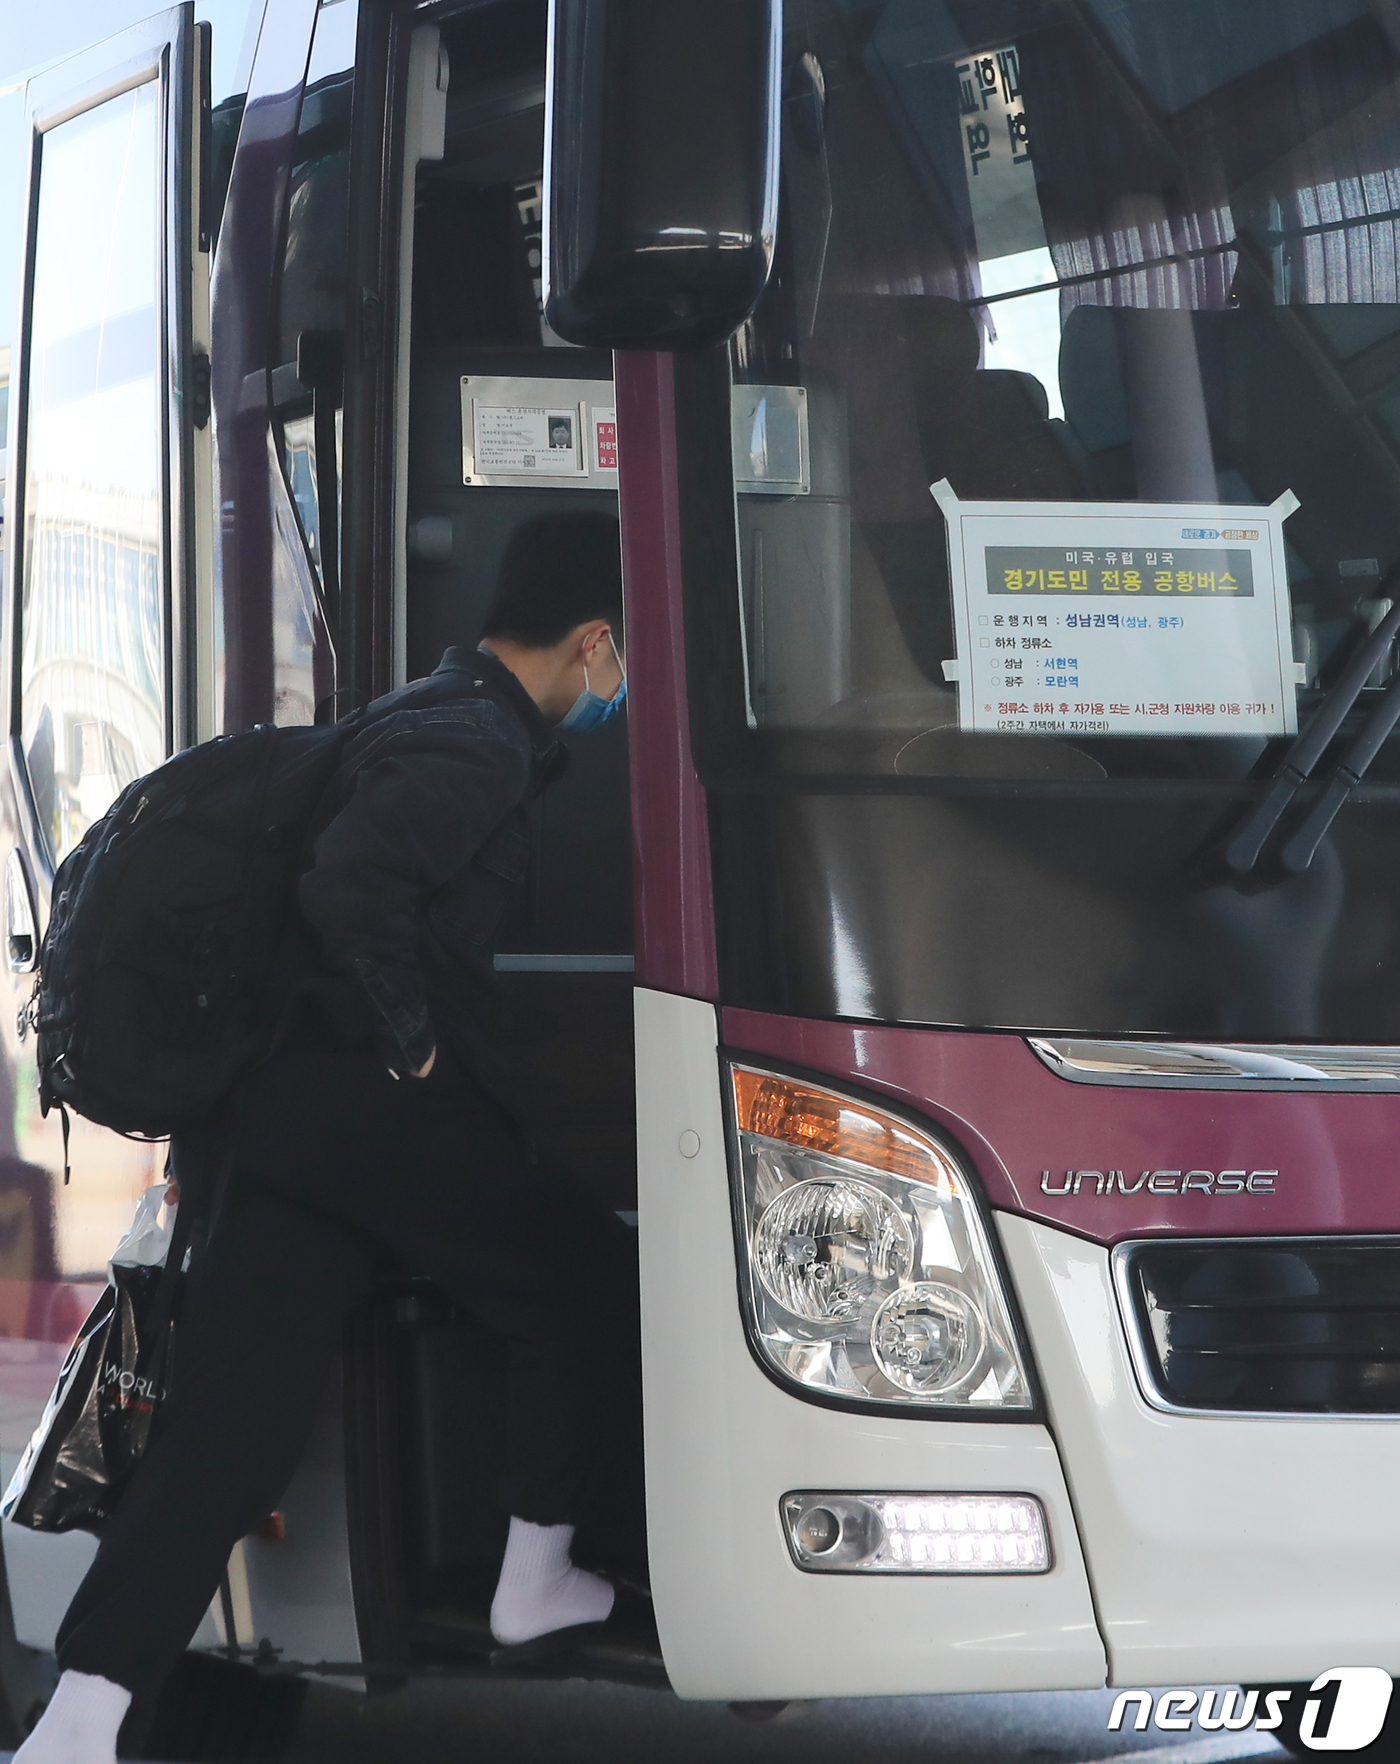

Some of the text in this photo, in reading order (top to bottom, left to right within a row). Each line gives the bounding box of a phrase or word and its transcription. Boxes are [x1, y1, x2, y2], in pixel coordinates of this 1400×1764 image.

[1145, 552, 1174, 566] 입국
[1004, 569, 1238, 593] 경기도민 전용 공항버스
[1157, 616, 1184, 628] 광주)
[995, 637, 1053, 649] 하차 정류소
[1004, 658, 1023, 670] 성남
[1044, 658, 1078, 670] 서현역
[1005, 676, 1024, 687] 광주
[1045, 676, 1079, 687] 모란역
[998, 703, 1029, 714] 정류소
[1033, 703, 1054, 714] 하차
[1058, 703, 1069, 714] 후
[1074, 703, 1105, 715] 자가용
[1109, 703, 1130, 715] 또는
[1174, 703, 1215, 715] 지원차량
[1220, 703, 1241, 715] 이용
[1245, 703, 1266, 715] 귀가
[1029, 720, 1065, 731] 자택에서
[1040, 1169, 1279, 1196] UNIVERSE
